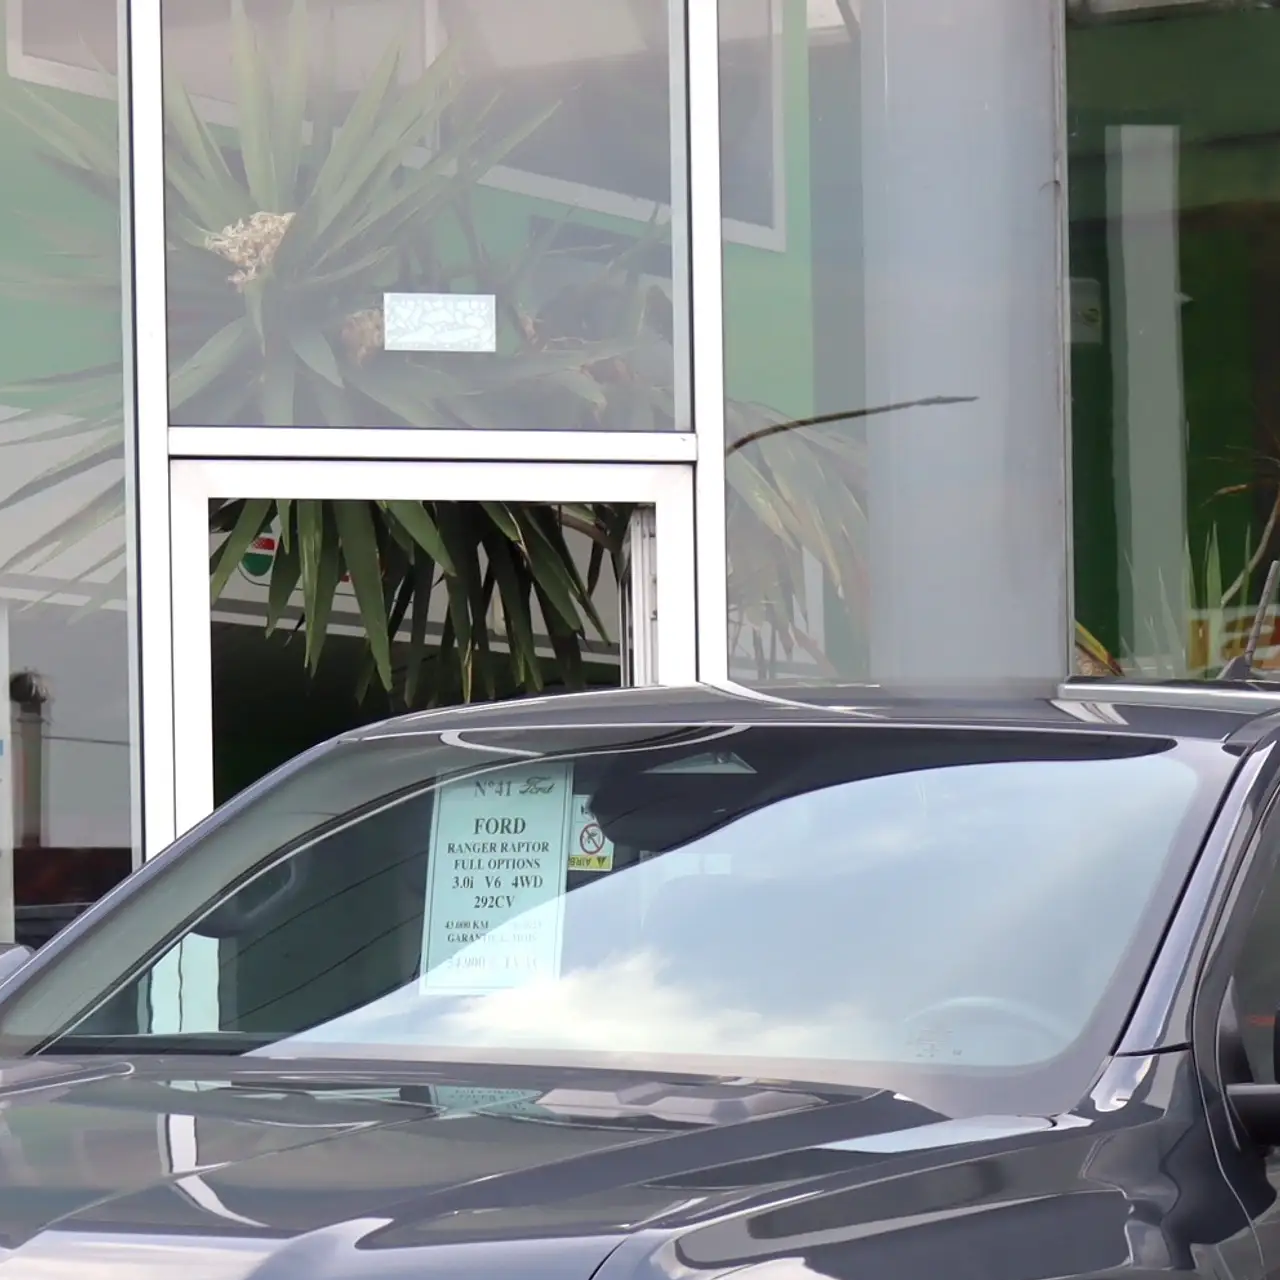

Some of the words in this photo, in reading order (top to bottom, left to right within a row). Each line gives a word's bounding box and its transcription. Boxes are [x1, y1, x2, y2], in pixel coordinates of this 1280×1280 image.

[519, 776, 555, 795] Ford
[473, 816, 527, 835] FORD
[446, 842, 497, 854] RANGER
[500, 841, 550, 853] RAPTOR
[454, 859, 485, 871] FULL
[487, 858, 541, 869] OPTIONS
[452, 875, 474, 889] 3.0i
[484, 875, 502, 889] V6
[511, 875, 544, 889] 4WD
[473, 895, 515, 909] 292CV
